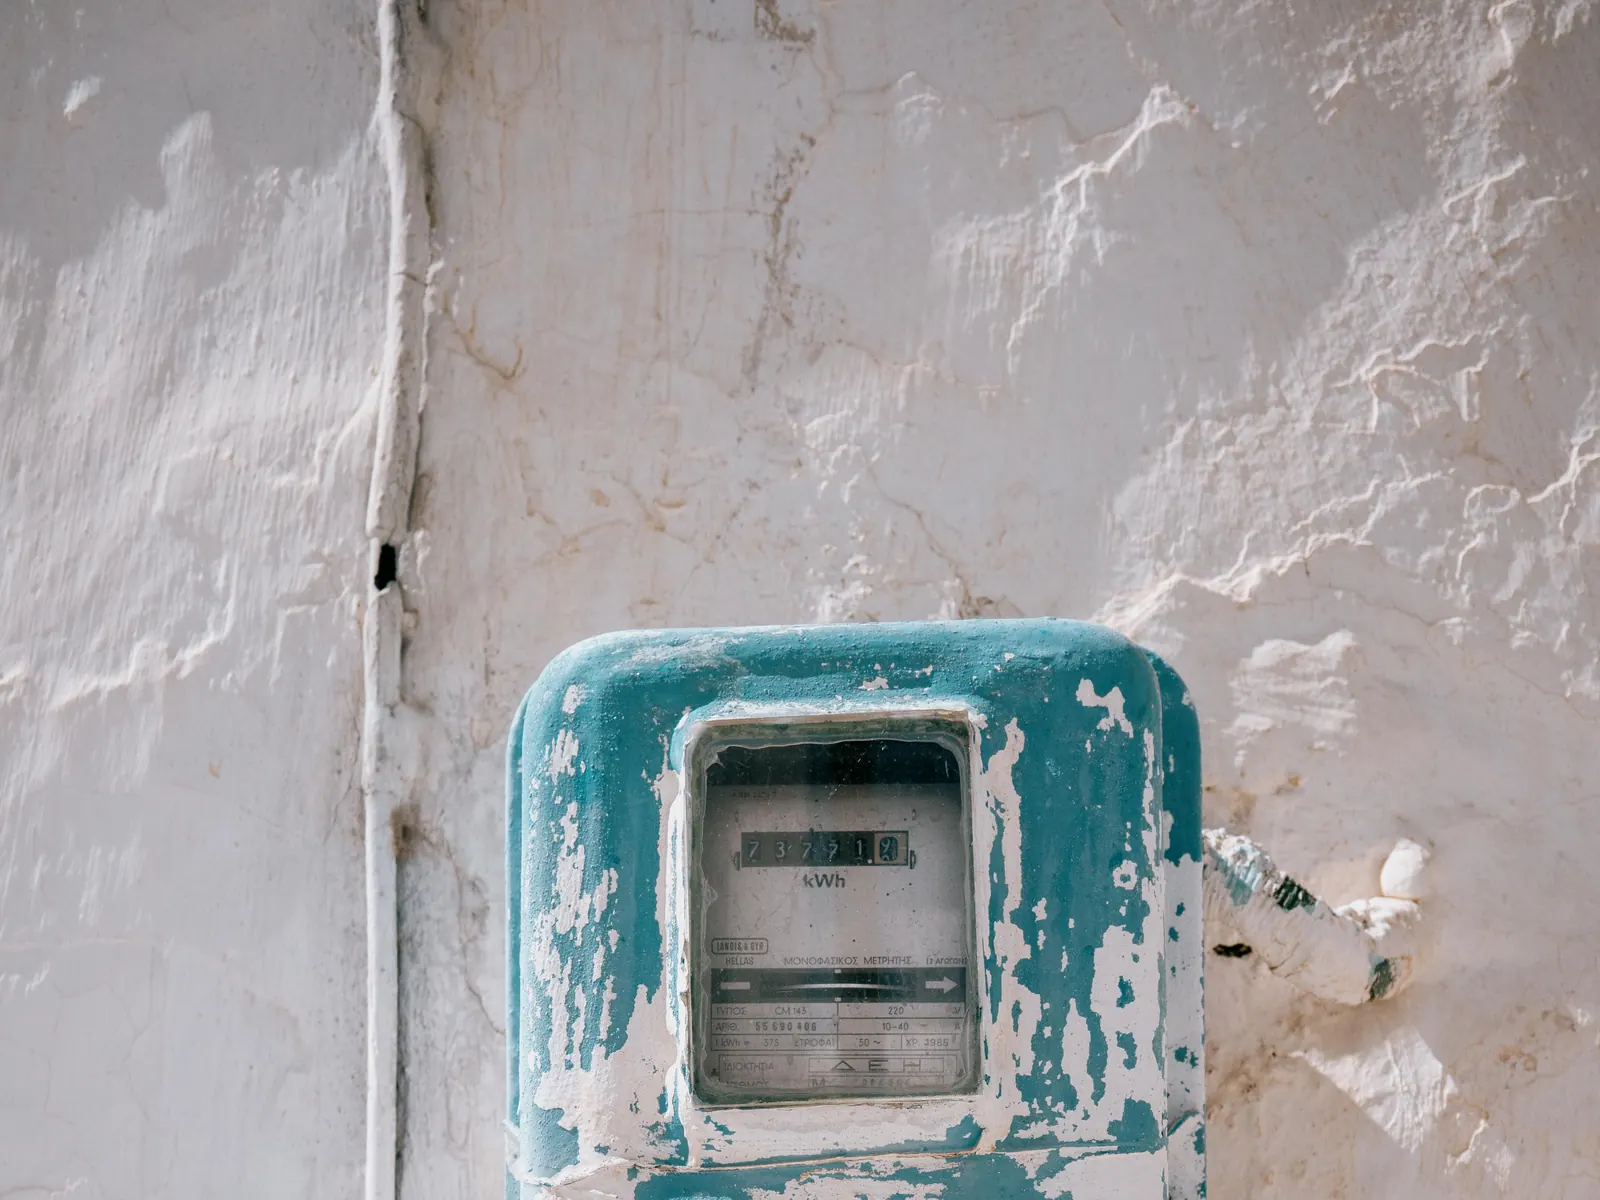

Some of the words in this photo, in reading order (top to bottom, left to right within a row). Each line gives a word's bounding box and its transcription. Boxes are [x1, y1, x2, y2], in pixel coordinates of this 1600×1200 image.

[802, 873, 846, 888] kWh
[716, 941, 742, 951] LANDIS
[750, 941, 764, 951] GYR
[725, 956, 754, 966] HELLAS
[784, 956, 858, 966] ΜΟΝΟΦΑΣΙΚΟΣ
[863, 956, 911, 966] ΜΕΤΡΗΤΗΣ
[715, 1006, 747, 1016] ΤΥΠΟΣ
[888, 1006, 904, 1015] 220
[882, 1022, 909, 1031] 10-40
[720, 1038, 740, 1047] kWh
[763, 1038, 779, 1047] 375
[859, 1038, 869, 1047] 50
